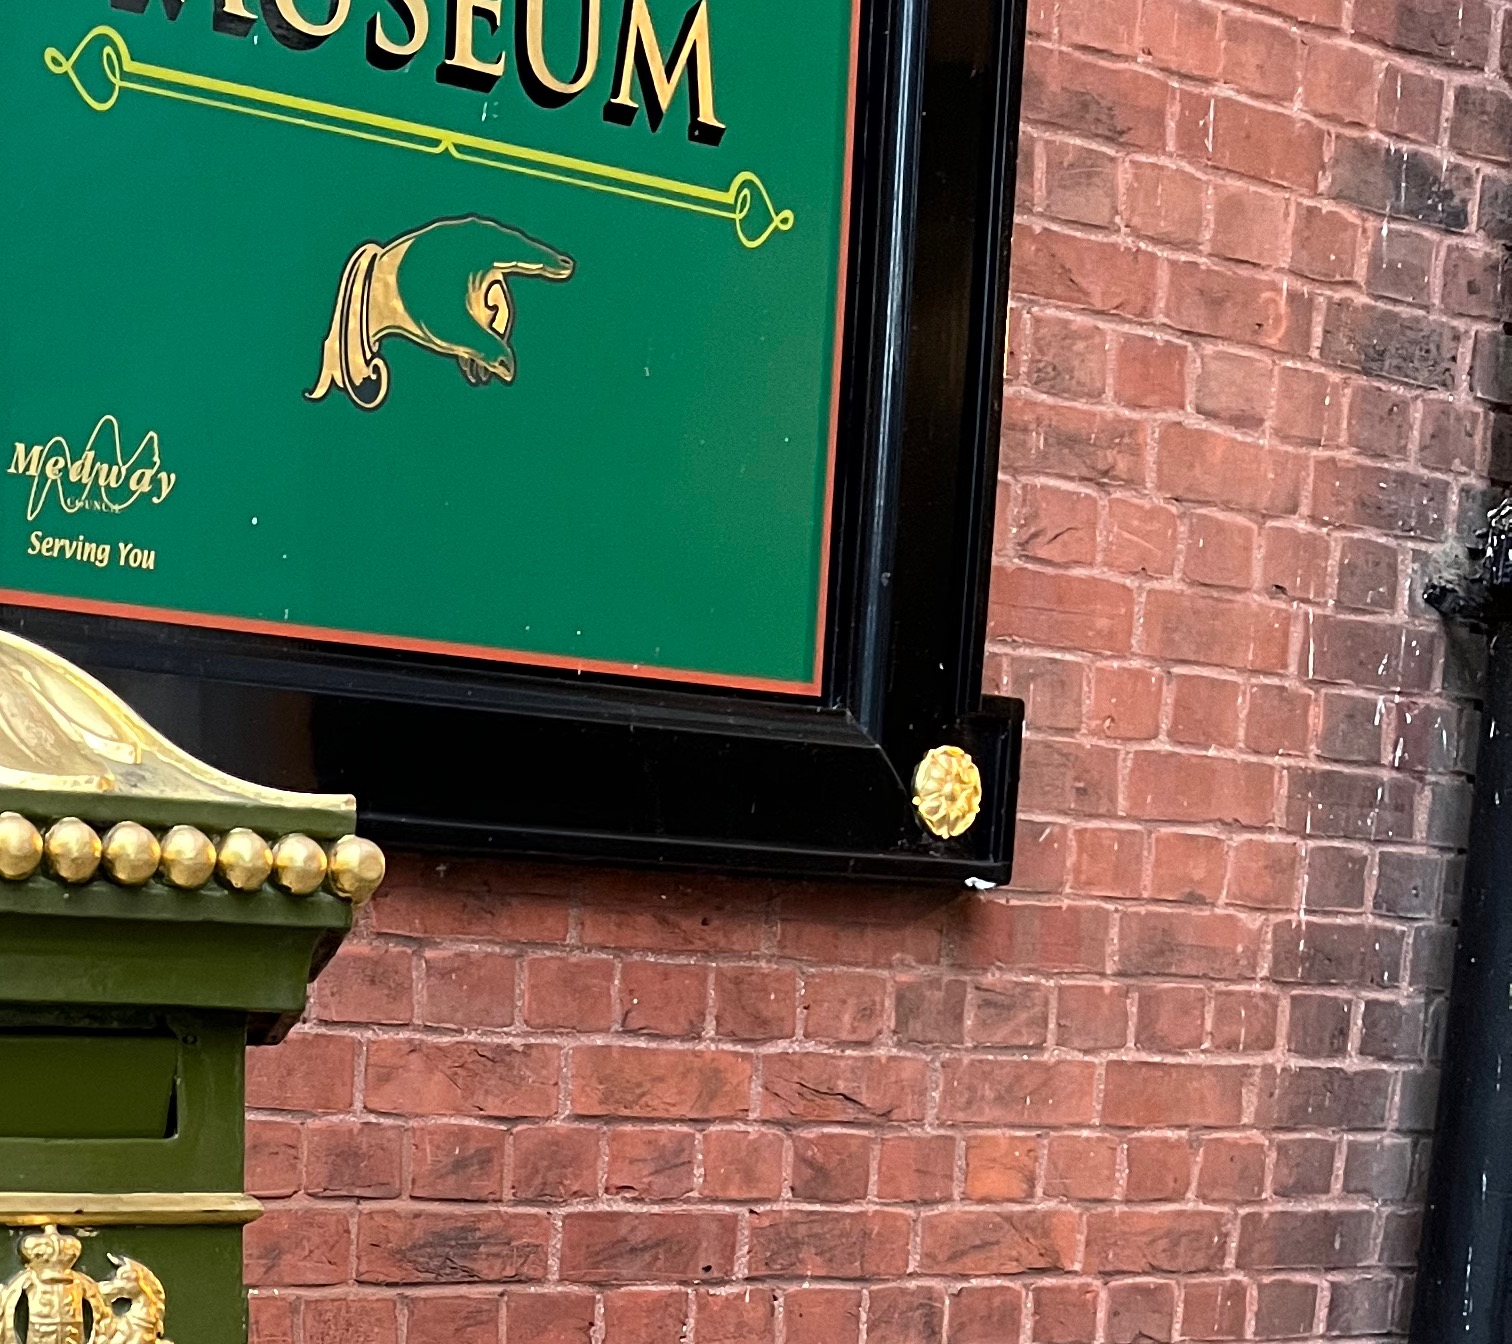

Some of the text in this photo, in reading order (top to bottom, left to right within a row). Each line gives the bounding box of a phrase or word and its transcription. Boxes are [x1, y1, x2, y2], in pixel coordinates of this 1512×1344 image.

[6, 441, 177, 504] Medway
[28, 530, 156, 570] Serving You
